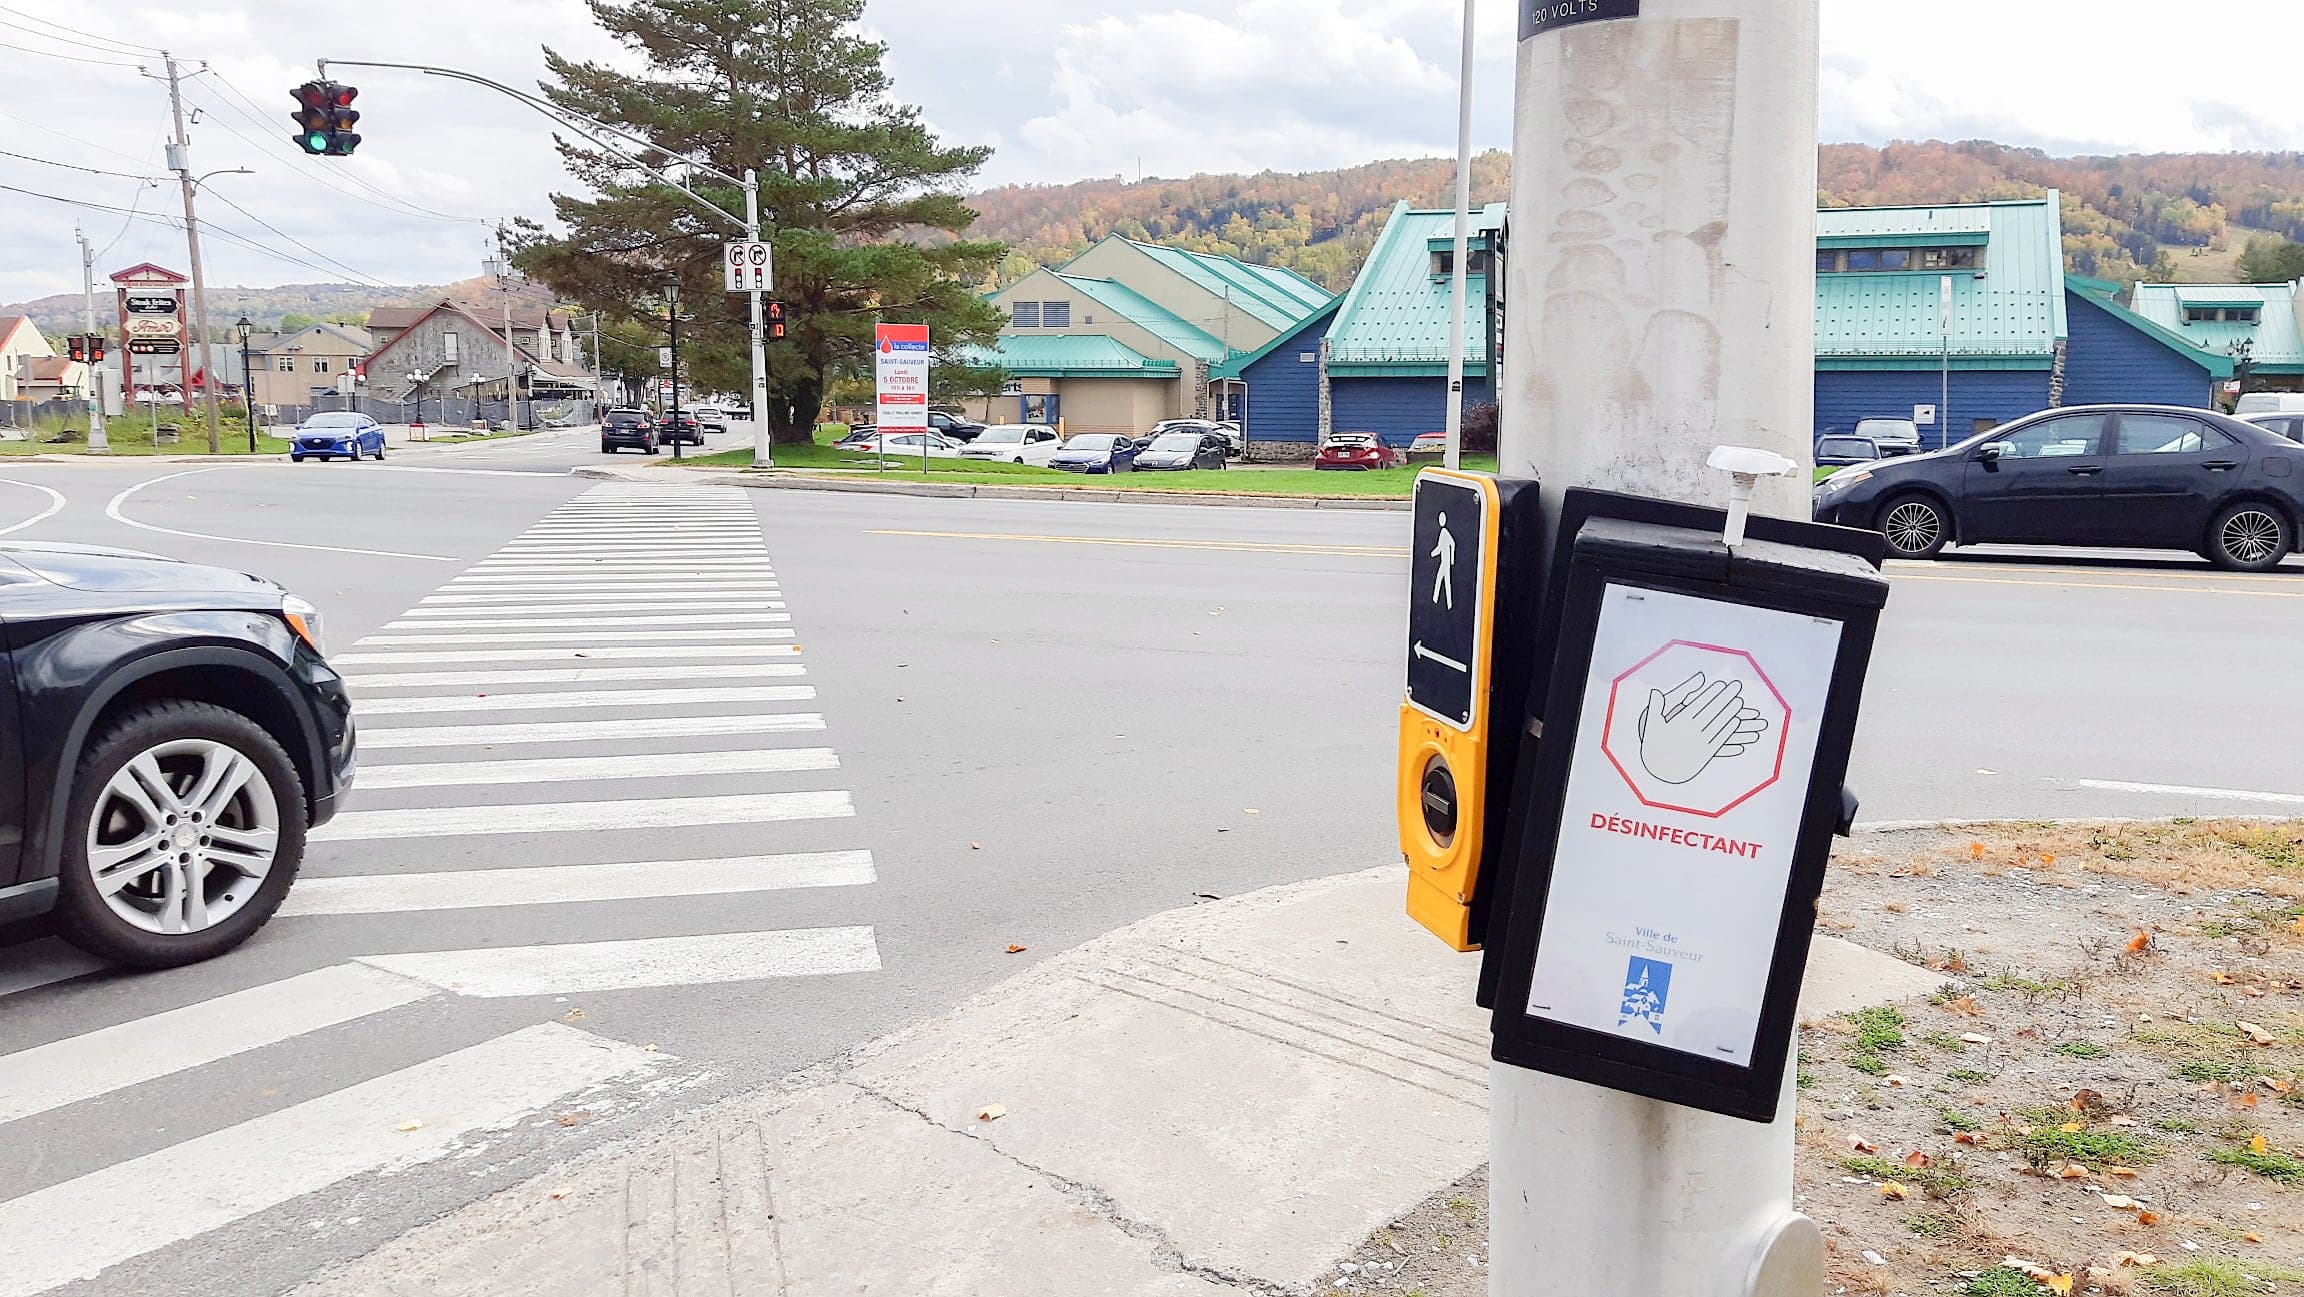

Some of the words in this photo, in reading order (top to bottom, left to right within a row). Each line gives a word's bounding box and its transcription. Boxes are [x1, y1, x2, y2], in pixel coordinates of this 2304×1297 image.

[1532, 8, 1548, 25] 120
[1551, 0, 1598, 19] VOLTS
[880, 358, 925, 366] SAINT-SAUVEUR
[889, 376, 919, 384] OCTOBRE
[1590, 812, 1763, 859] DÉSINFECTANT
[1635, 926, 1660, 940] Ville
[1663, 932, 1678, 943] de
[1605, 931, 1705, 962] Saint-Sauveur
